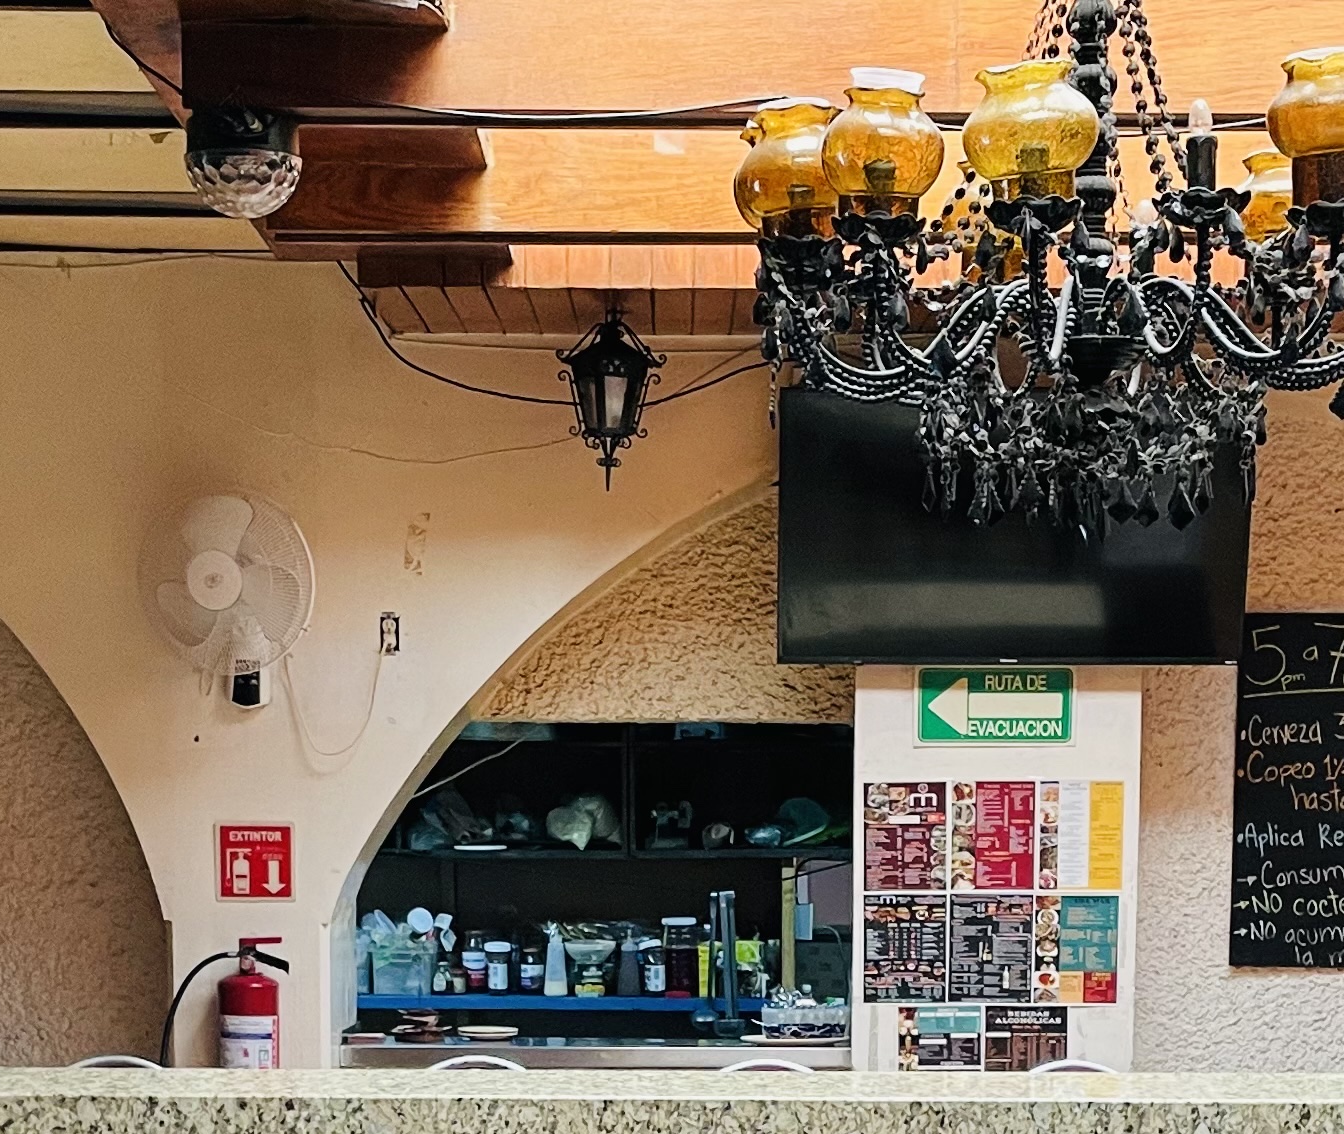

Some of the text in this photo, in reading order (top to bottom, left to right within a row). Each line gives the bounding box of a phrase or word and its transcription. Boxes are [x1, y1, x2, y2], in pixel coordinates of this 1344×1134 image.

[984, 674, 1048, 691] RUTA DE
[967, 720, 1062, 737] EVACUACION
[1246, 750, 1316, 787] Copeo
[229, 830, 282, 842] EXTINTOR
[1245, 822, 1305, 857] Aplica
[1252, 889, 1283, 914] NO
[1249, 919, 1277, 941] NO
[1295, 946, 1314, 966] la
